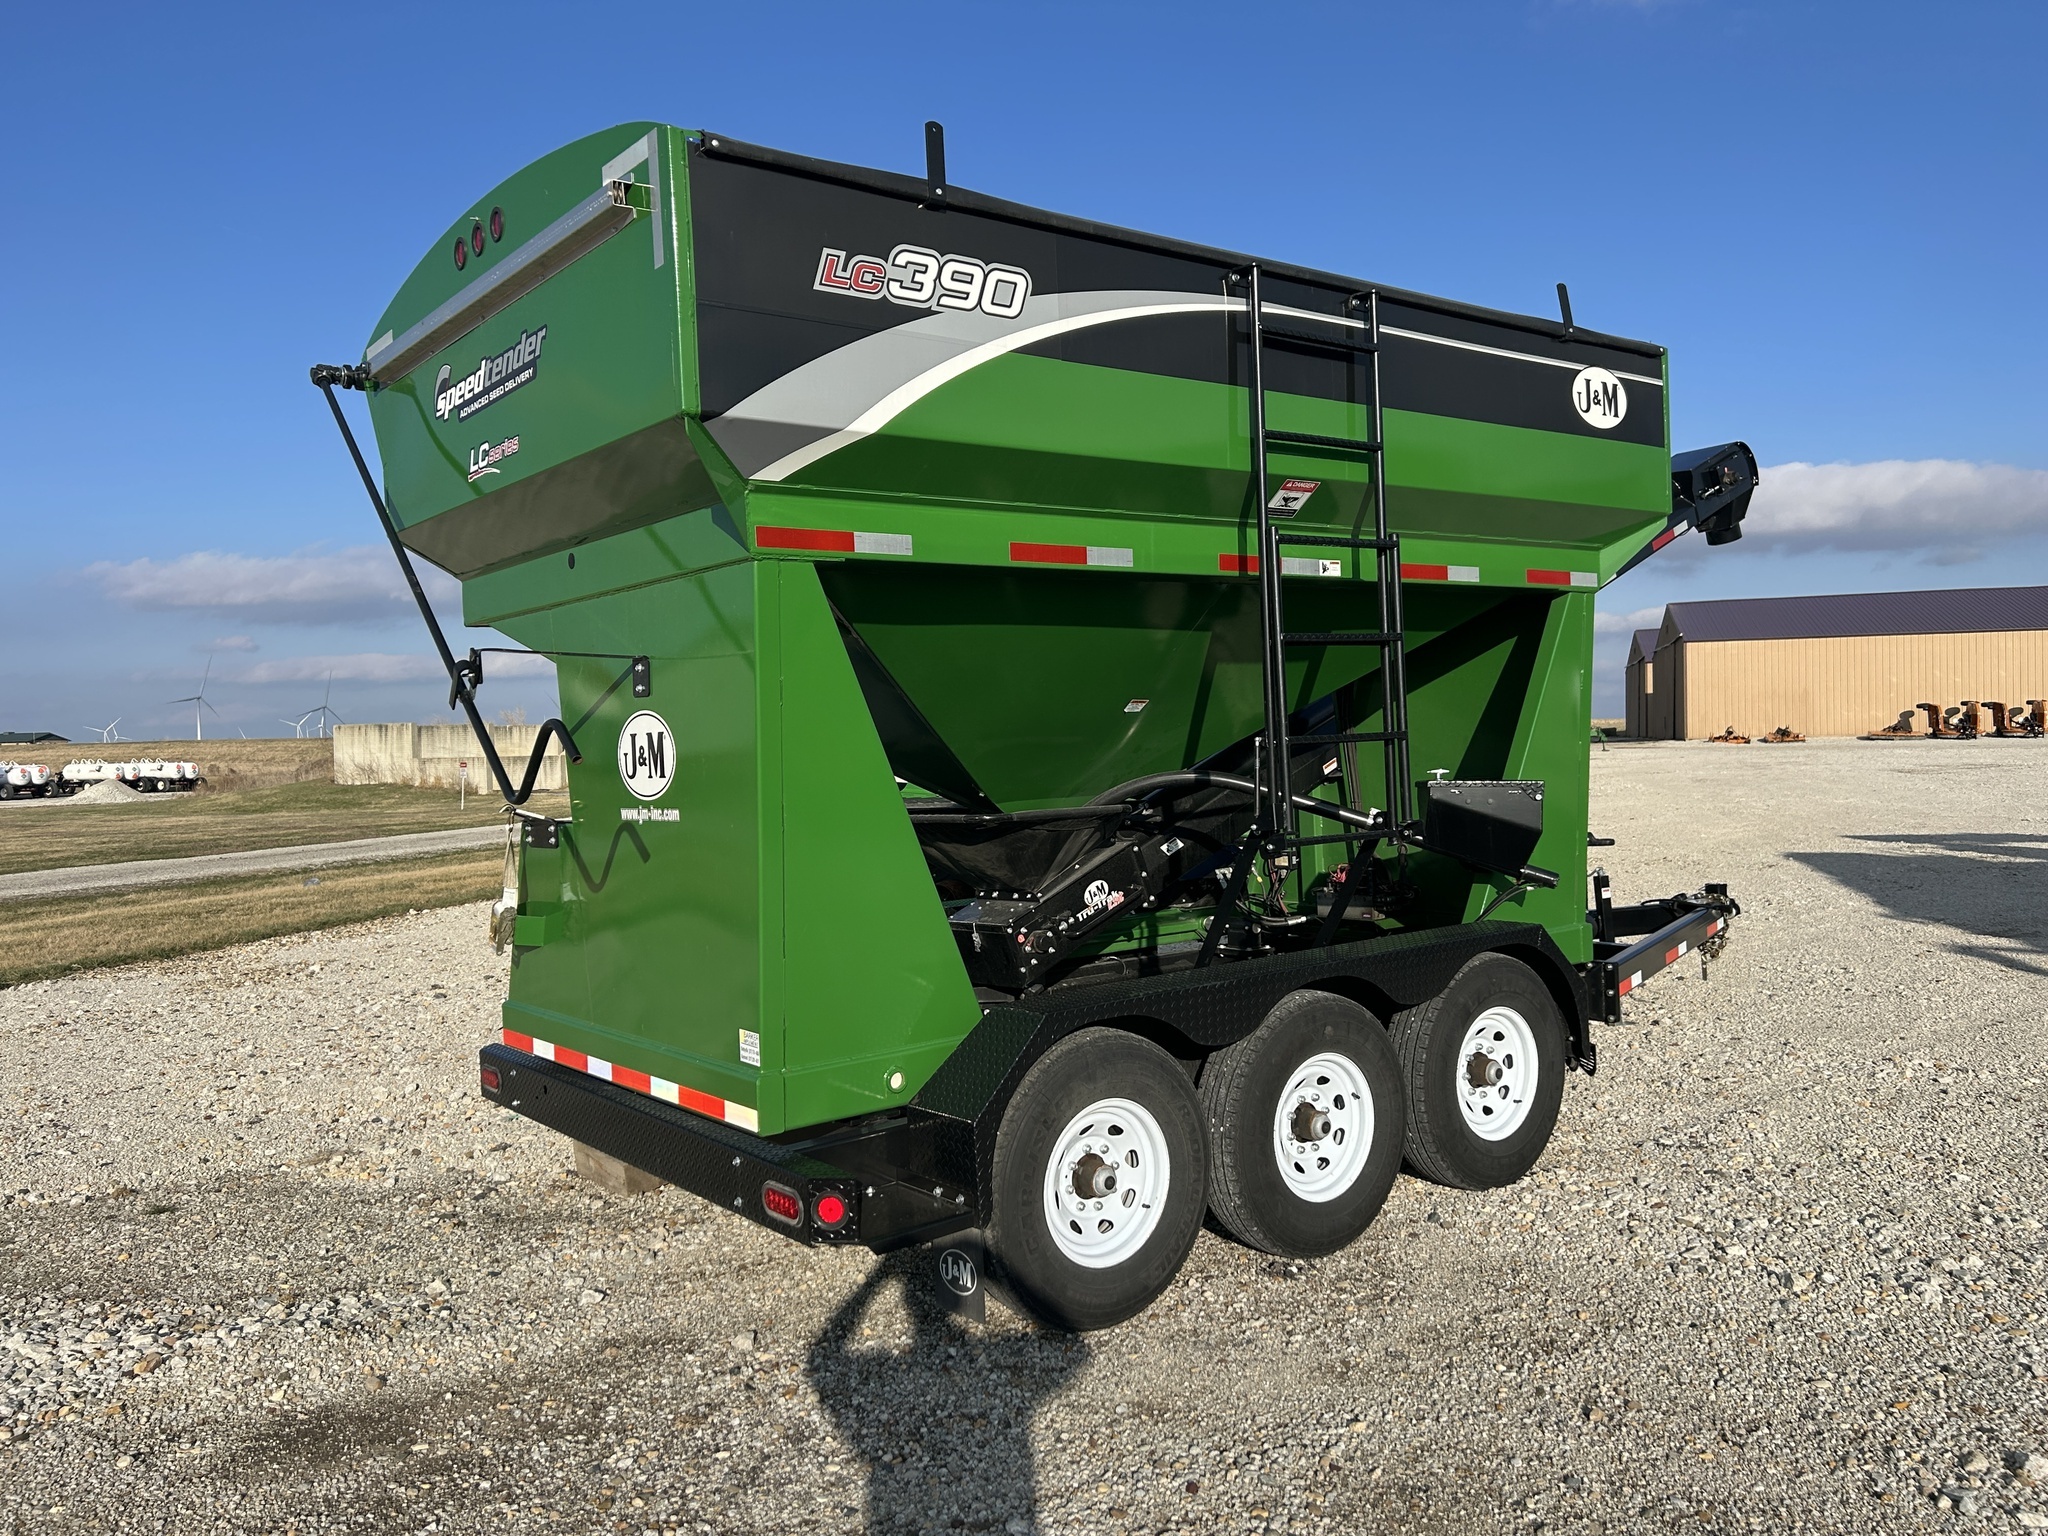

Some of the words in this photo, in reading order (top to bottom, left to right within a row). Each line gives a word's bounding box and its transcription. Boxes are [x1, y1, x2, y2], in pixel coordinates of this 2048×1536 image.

[459, 395, 489, 419] ADVANCED
[489, 387, 505, 401] SEED
[505, 366, 534, 390] DELIVERY
[1577, 378, 1619, 418] J&M
[1292, 481, 1316, 489] DANGER
[623, 731, 666, 779] J&M
[620, 805, 680, 825] www.jm-inc.com
[1086, 882, 1107, 905] J&M
[942, 1255, 972, 1288] J&M
